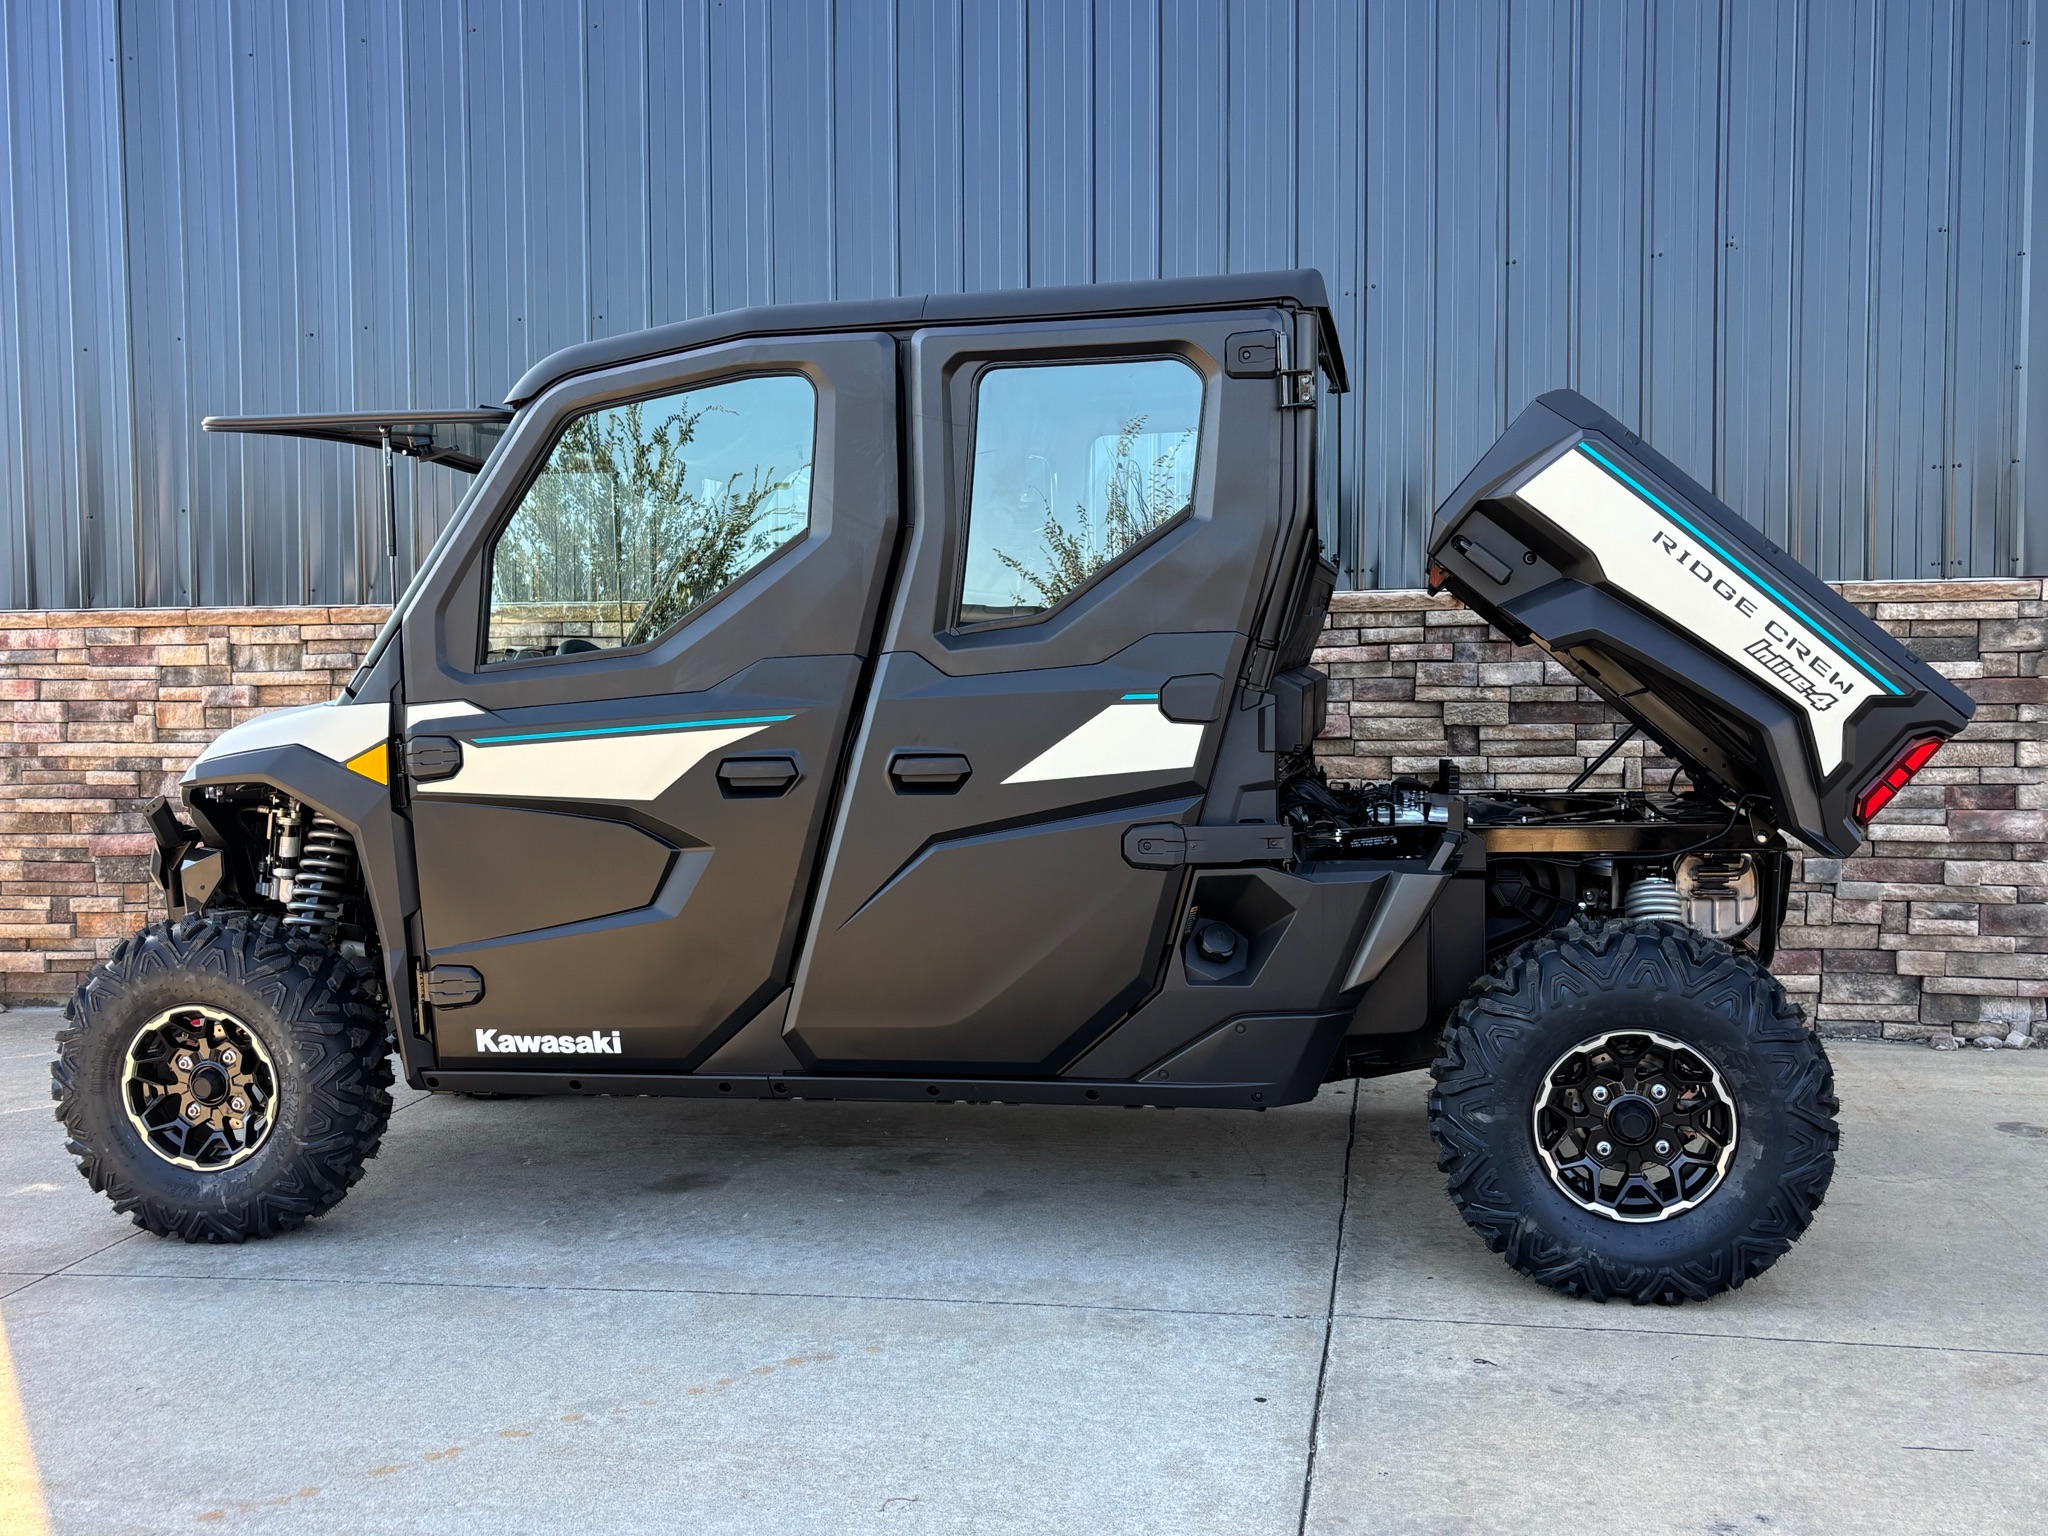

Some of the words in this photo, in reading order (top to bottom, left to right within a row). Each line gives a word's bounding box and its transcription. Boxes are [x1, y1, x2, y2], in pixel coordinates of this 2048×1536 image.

[1652, 530, 1758, 618] RIDGE
[1764, 620, 1855, 695] CREW
[475, 1029, 622, 1054] Kawasaki
